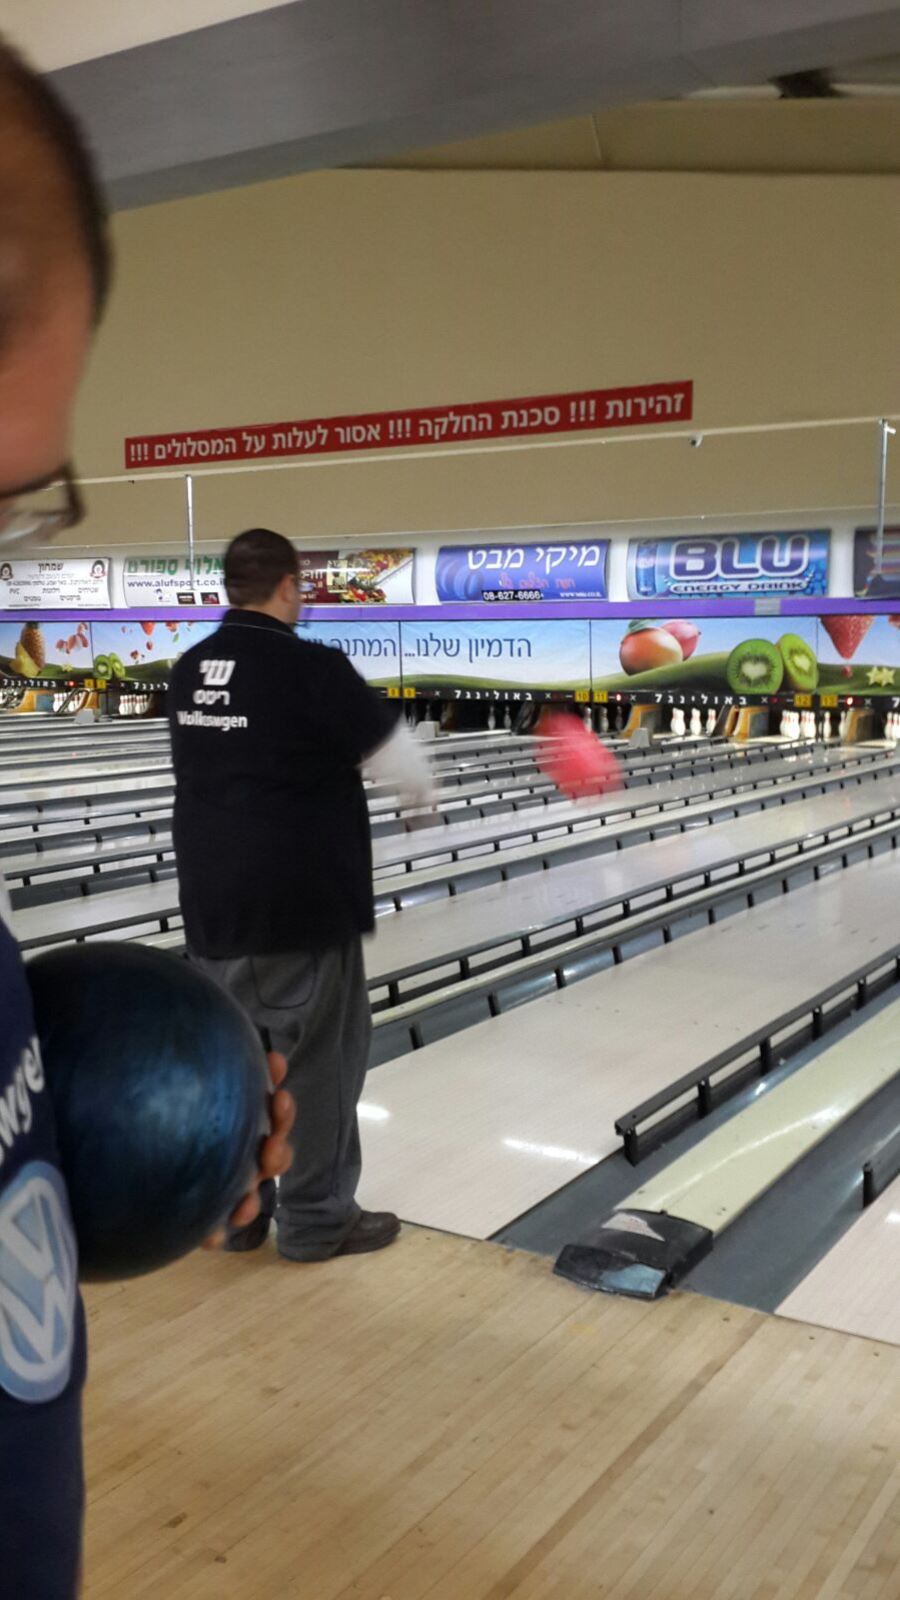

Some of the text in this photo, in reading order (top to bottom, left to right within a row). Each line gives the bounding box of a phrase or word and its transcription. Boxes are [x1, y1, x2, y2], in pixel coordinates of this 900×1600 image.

[130, 392, 684, 462] זהירות !!! סכנת החלקה !!! אסור לעלות על המסלולים !!!
[467, 545, 600, 575] מיקי מבט
[669, 535, 809, 580] BLU
[672, 581, 804, 593] ENERGY DRINK
[404, 632, 461, 658] שלנו...
[467, 637, 532, 663] הדמיון
